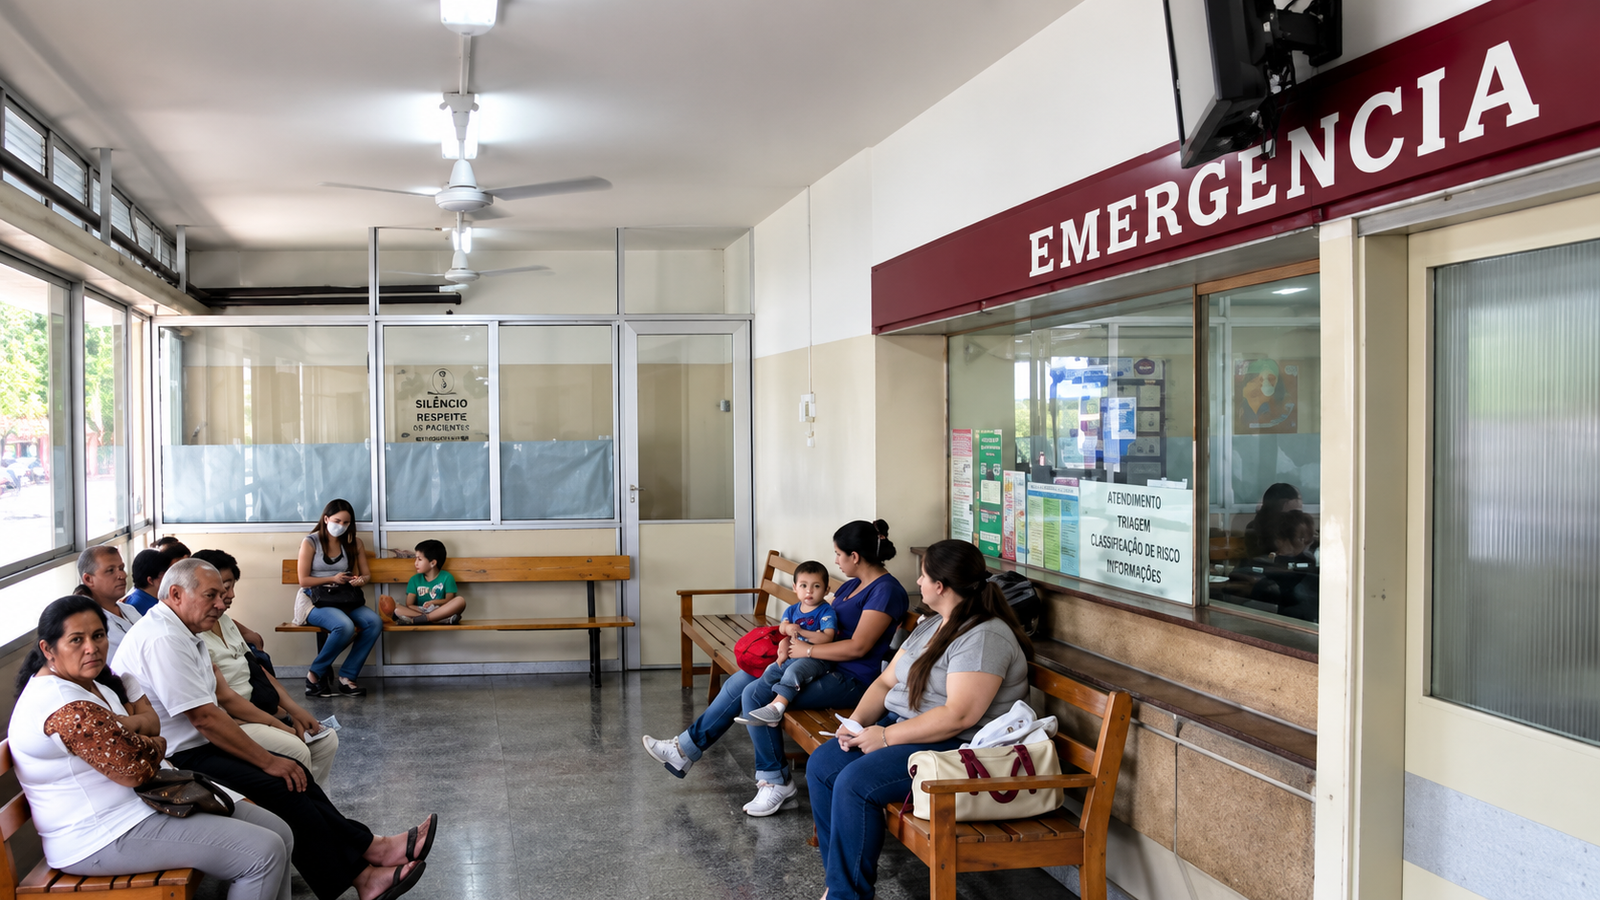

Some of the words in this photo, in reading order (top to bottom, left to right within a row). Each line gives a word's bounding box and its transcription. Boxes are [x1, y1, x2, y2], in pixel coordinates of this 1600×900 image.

[1029, 41, 1540, 278] EMERGENCIA
[415, 396, 468, 409] SILÊNCIO
[416, 412, 467, 422] RESPEITE
[413, 424, 423, 432] OS
[425, 424, 470, 432] PACIENTES
[1107, 491, 1161, 509] ATENDIMENTO
[1117, 515, 1151, 532] TRIAGEM
[1145, 543, 1155, 558] DE
[1156, 545, 1181, 564] RISCO
